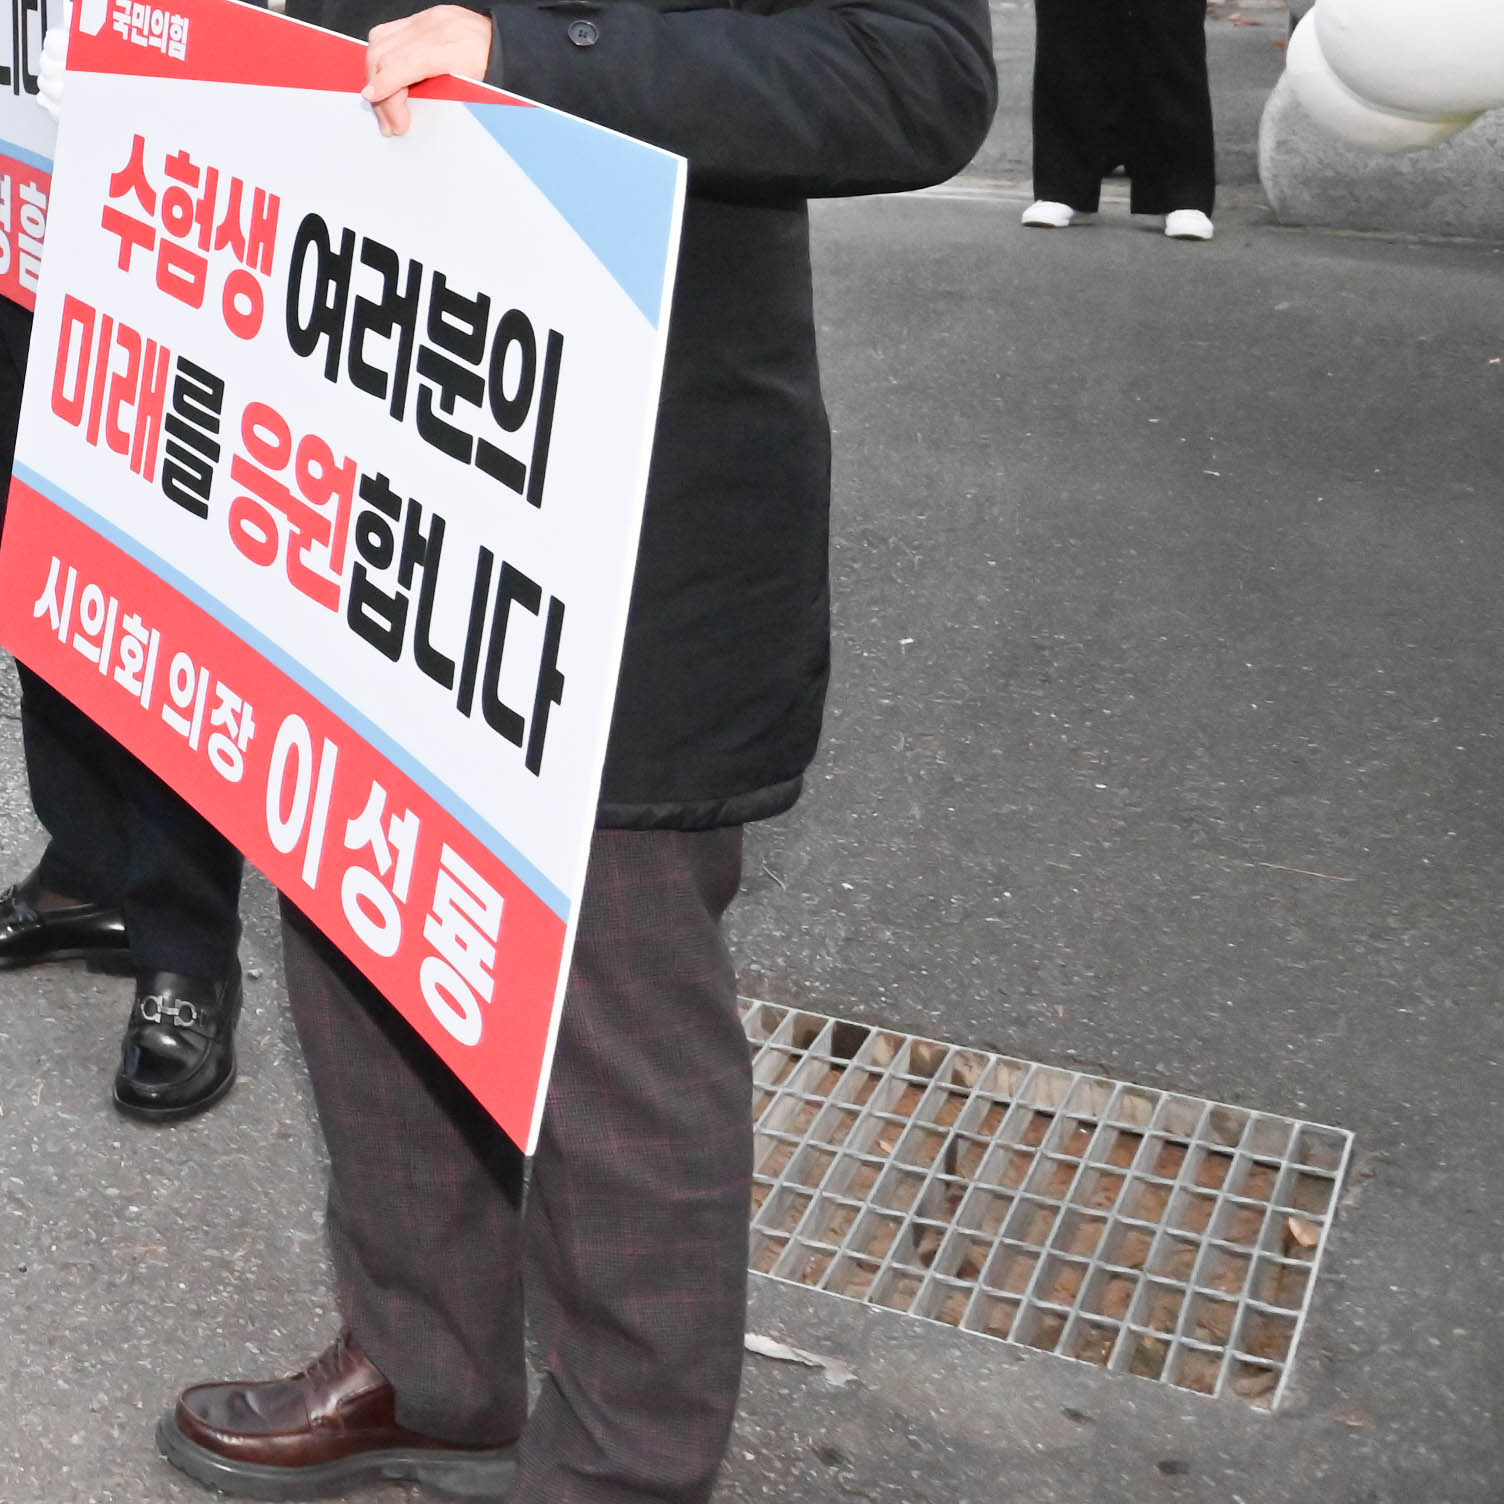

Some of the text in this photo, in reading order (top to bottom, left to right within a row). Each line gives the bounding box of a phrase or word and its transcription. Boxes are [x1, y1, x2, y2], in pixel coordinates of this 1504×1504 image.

[51, 293, 565, 776] 미래를 응원합니다
[101, 133, 563, 508] 수험생 여러분의
[34, 556, 504, 1046] 시의회 의장 이성룡
